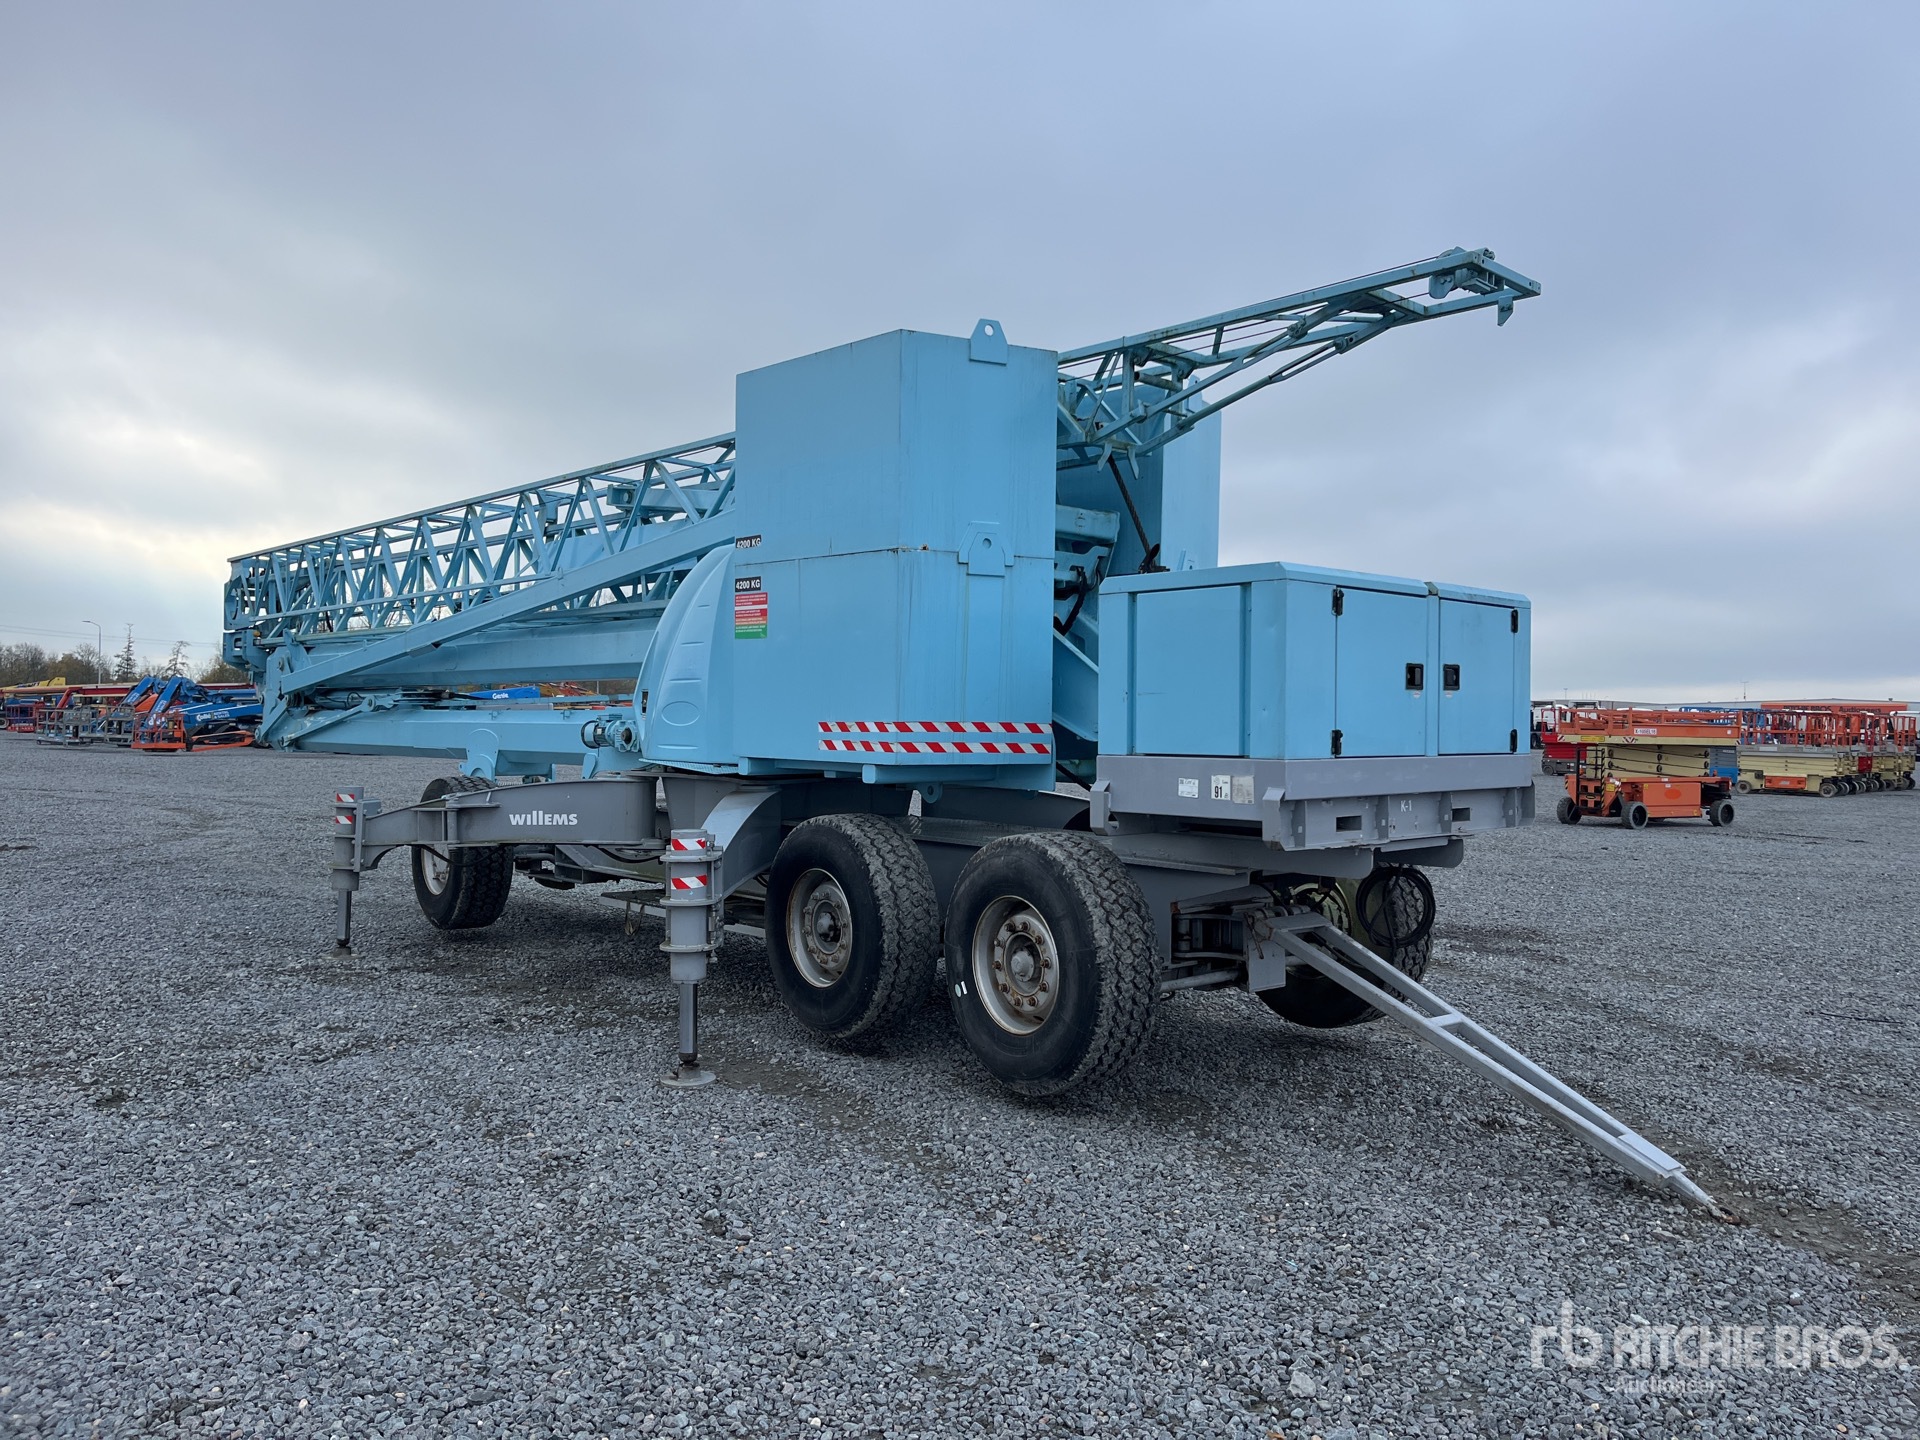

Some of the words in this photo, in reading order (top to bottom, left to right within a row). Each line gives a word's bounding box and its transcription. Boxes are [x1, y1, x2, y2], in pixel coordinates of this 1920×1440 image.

[736, 540, 751, 549] 4200
[751, 538, 761, 547] KG
[735, 580, 750, 590] 4200
[750, 579, 761, 589] KG
[492, 692, 509, 700] Genie
[1214, 785, 1223, 799] 91
[1400, 799, 1412, 812] K-1
